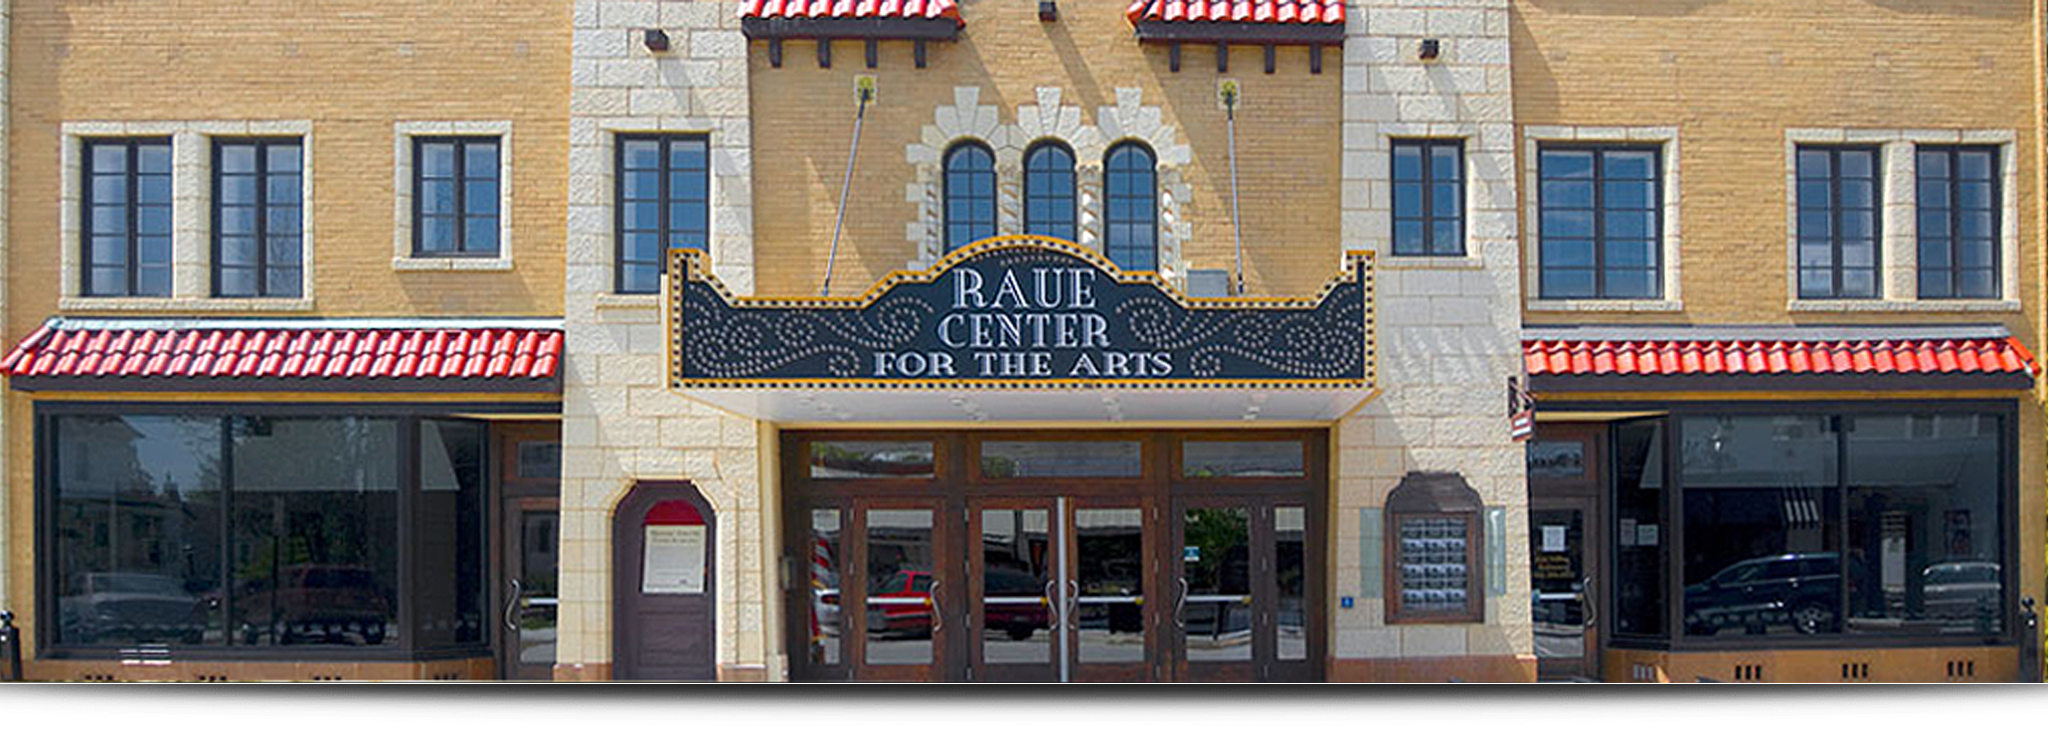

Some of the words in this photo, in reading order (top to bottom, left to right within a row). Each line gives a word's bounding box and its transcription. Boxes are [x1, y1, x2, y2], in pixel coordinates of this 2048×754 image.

[951, 267, 1096, 309] RAUE
[938, 314, 1110, 348] CENTER
[874, 352, 957, 376] FOR
[974, 352, 1052, 376] THE
[1069, 352, 1173, 376] ARTS
